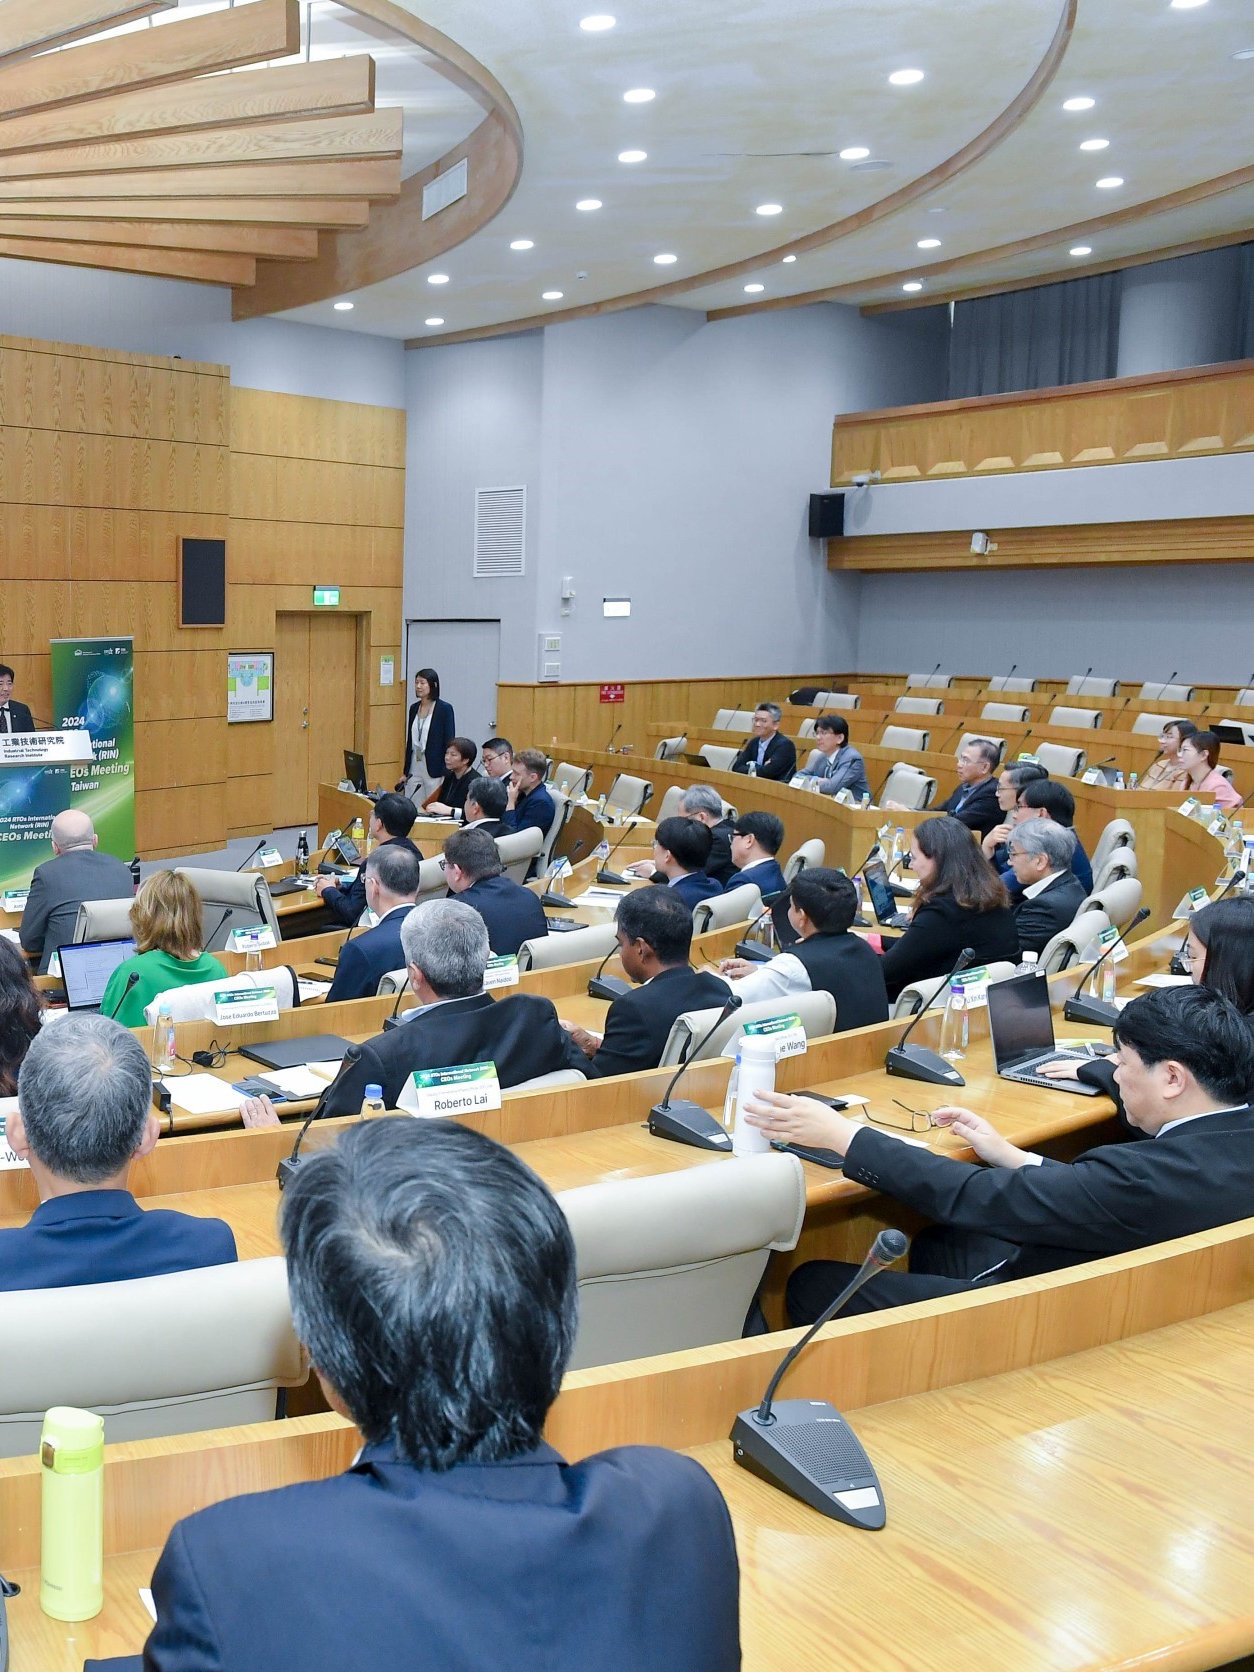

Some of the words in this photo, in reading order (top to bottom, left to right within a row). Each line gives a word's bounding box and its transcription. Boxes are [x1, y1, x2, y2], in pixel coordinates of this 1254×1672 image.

[61, 716, 86, 728] 2024
[2, 736, 65, 747] 工業技術研究院
[91, 737, 116, 749] tional
[98, 748, 120, 761] (RIN)
[70, 767, 89, 779] EOs
[91, 762, 130, 776] Meeting
[71, 781, 100, 792] Taiwan
[27, 814, 56, 822] Internatio
[23, 829, 54, 840] Meeti
[787, 1040, 806, 1051] Wang
[434, 1097, 473, 1110] Roberto
[474, 1092, 488, 1105] Lai
